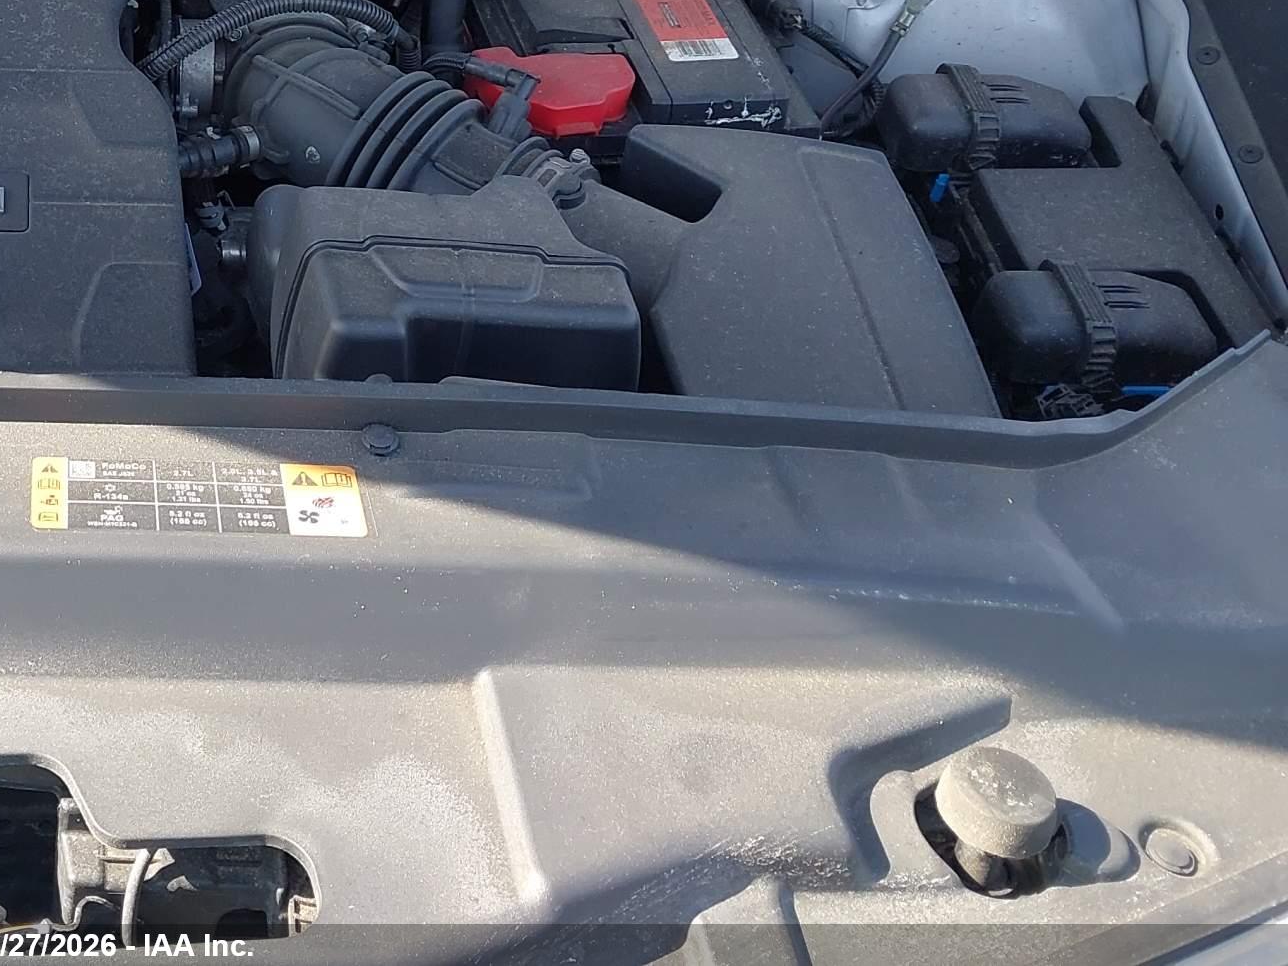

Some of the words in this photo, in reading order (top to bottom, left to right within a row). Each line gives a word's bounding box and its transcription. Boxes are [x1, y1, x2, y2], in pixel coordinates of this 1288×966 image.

[101, 461, 147, 471] FoMoCo
[93, 492, 129, 501] R-134a
[100, 514, 125, 522] PAG
